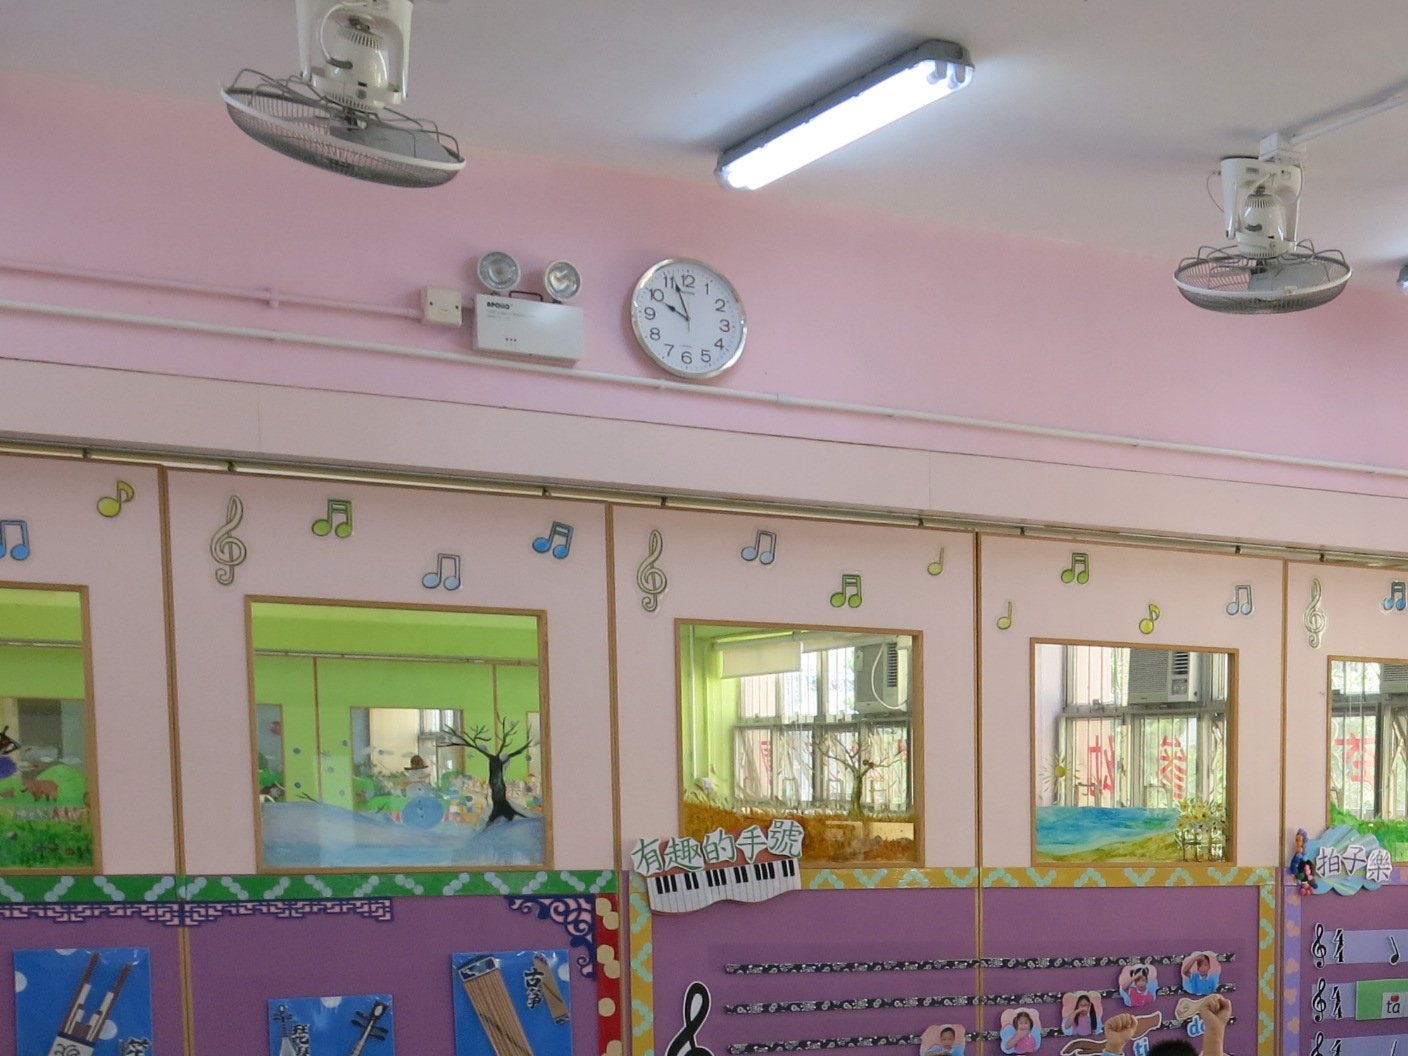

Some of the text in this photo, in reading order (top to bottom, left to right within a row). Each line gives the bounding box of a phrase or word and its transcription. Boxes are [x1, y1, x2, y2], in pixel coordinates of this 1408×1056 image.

[664, 276, 674, 288] 11
[681, 274, 695, 288] 12
[649, 288, 664, 302] 10
[715, 298, 725, 312] 2
[644, 306, 655, 320] 9
[720, 319, 730, 332] 3
[649, 327, 660, 341] 8
[664, 343, 674, 357] 7
[714, 338, 724, 350] 4
[681, 350, 692, 364] 6
[700, 349, 711, 363] 5
[631, 819, 803, 872] 有趣的手號
[1317, 846, 1391, 882] 拍子樂
[1386, 1001, 1400, 1014] ta
